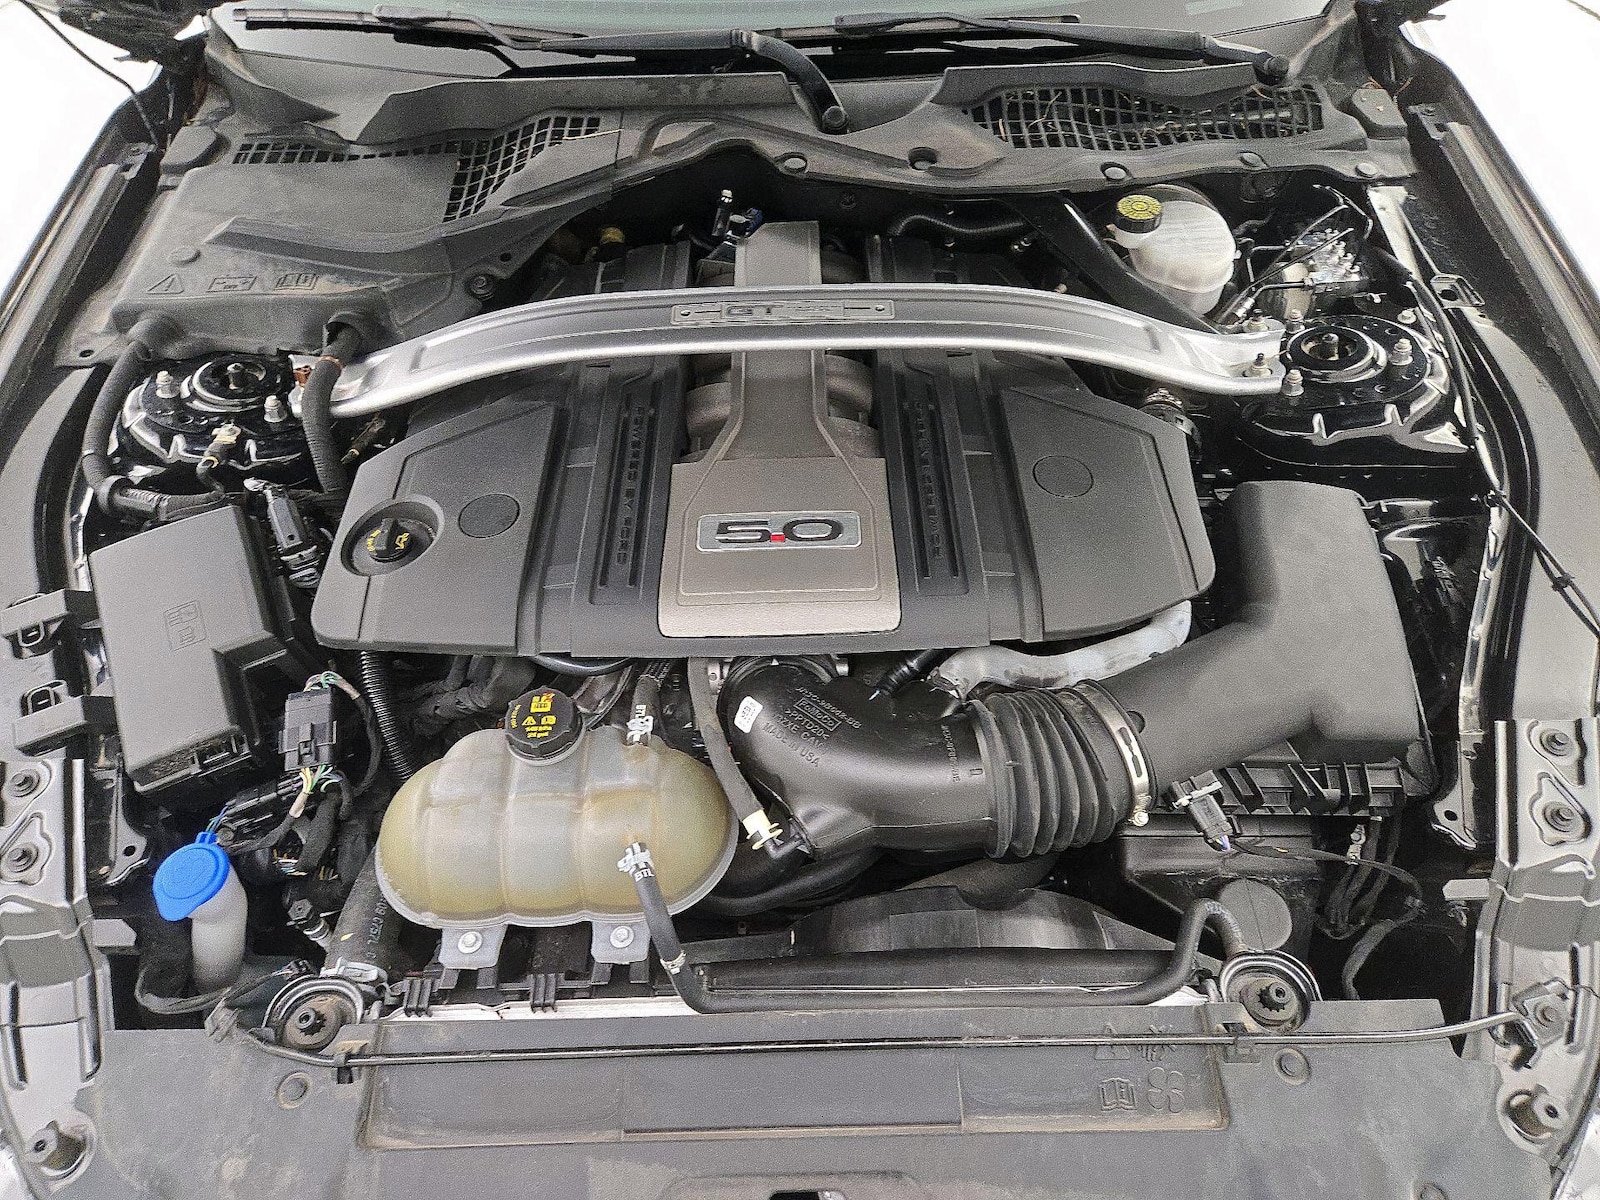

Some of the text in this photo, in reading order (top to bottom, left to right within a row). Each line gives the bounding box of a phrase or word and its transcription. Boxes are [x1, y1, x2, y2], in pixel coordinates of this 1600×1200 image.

[716, 518, 845, 544] 5.0
[798, 700, 835, 727] FoMoCo
[800, 746, 820, 768] USA
[633, 868, 656, 882] BTL
